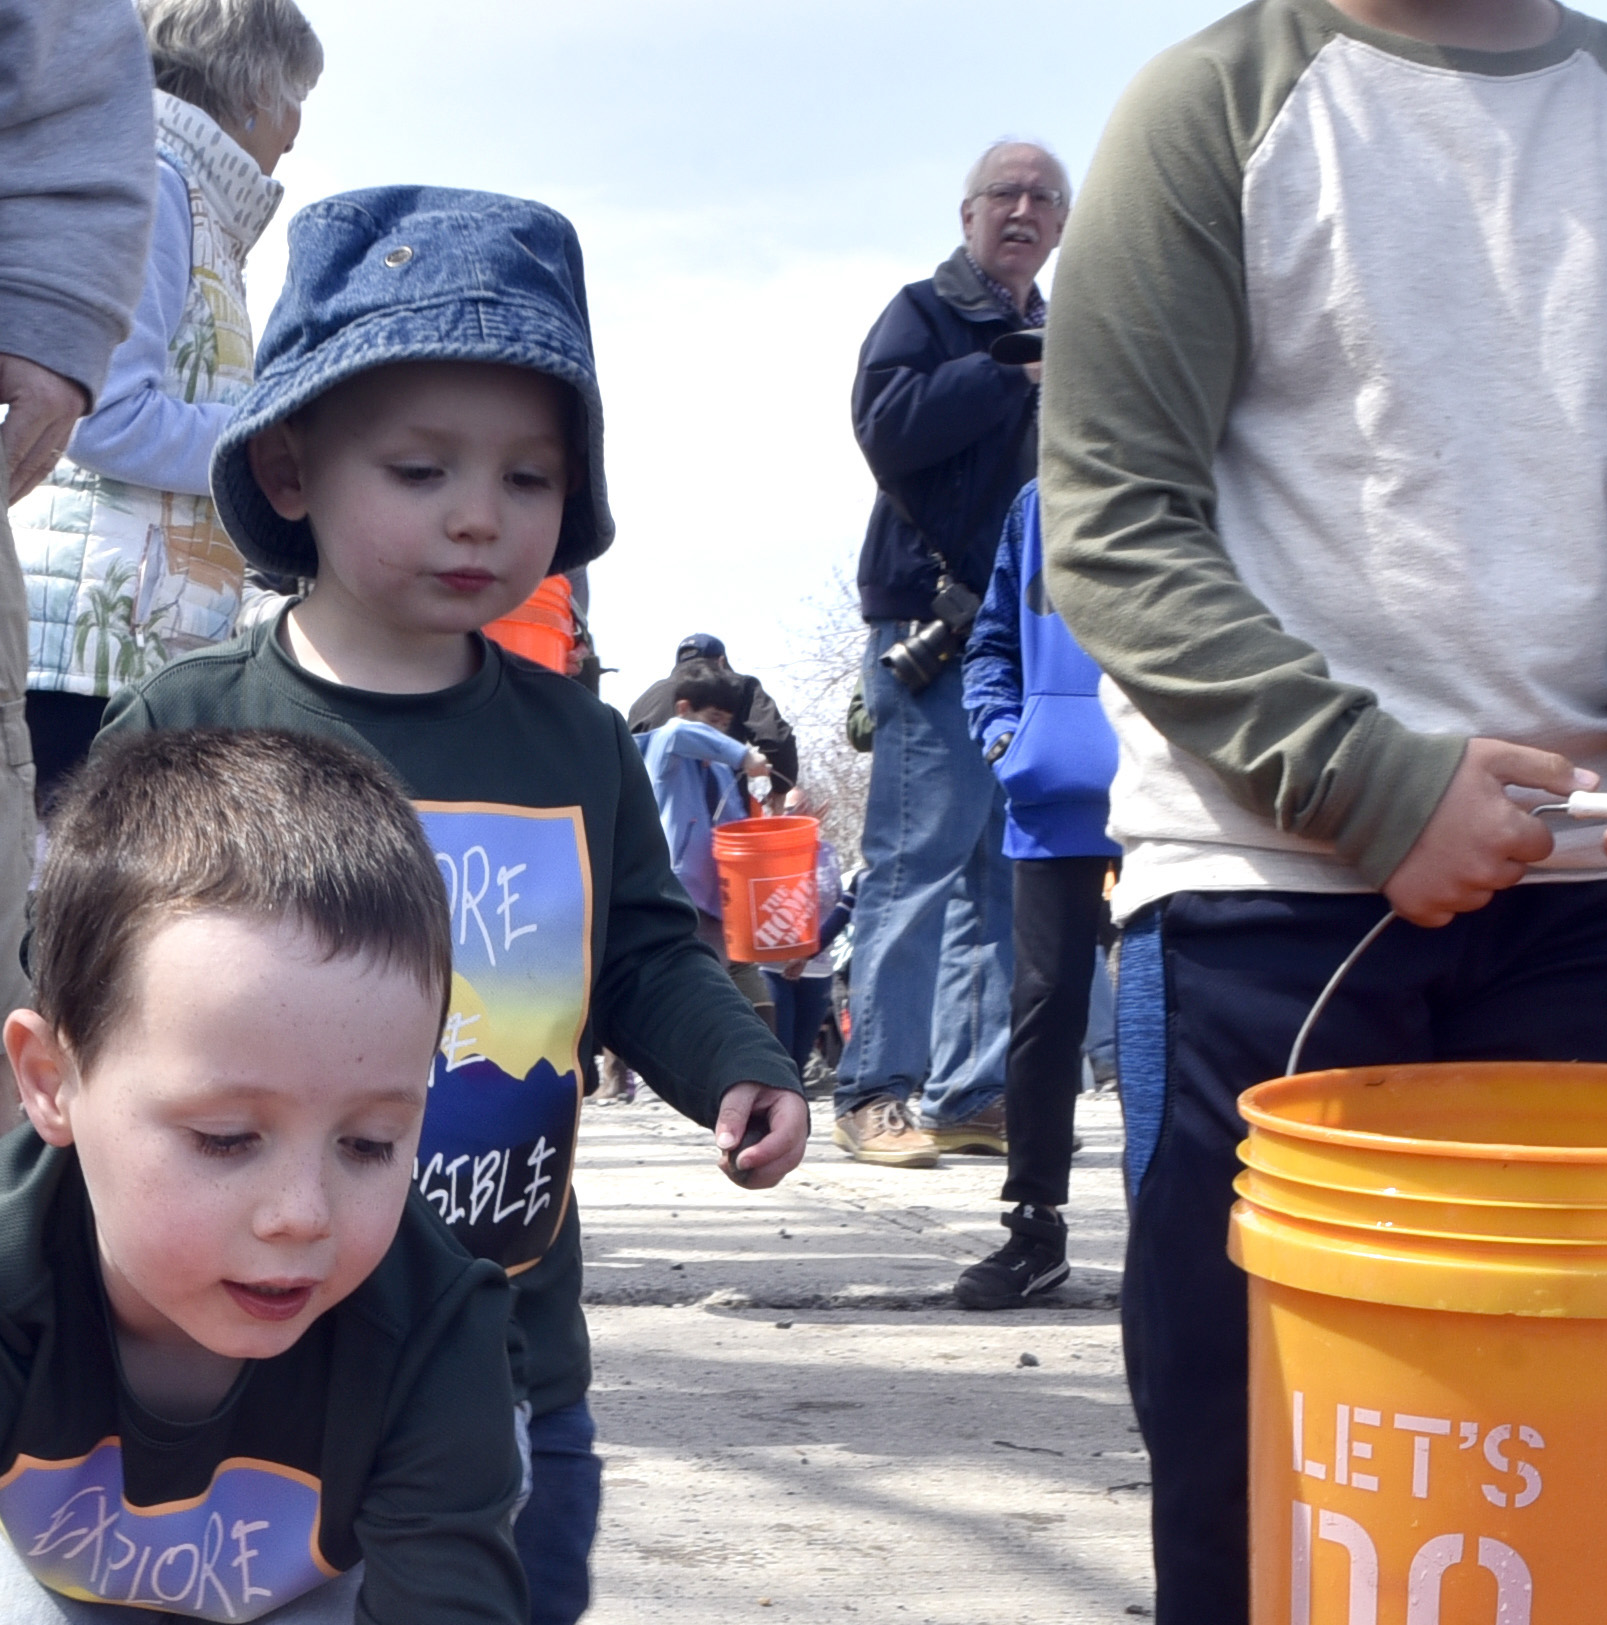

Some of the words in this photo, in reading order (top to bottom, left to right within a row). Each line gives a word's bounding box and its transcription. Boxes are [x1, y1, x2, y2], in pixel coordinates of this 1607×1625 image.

[413, 1135, 556, 1226] SIBLE
[1292, 1390, 1545, 1508] LET'S
[27, 1486, 272, 1618] EXPLORE
